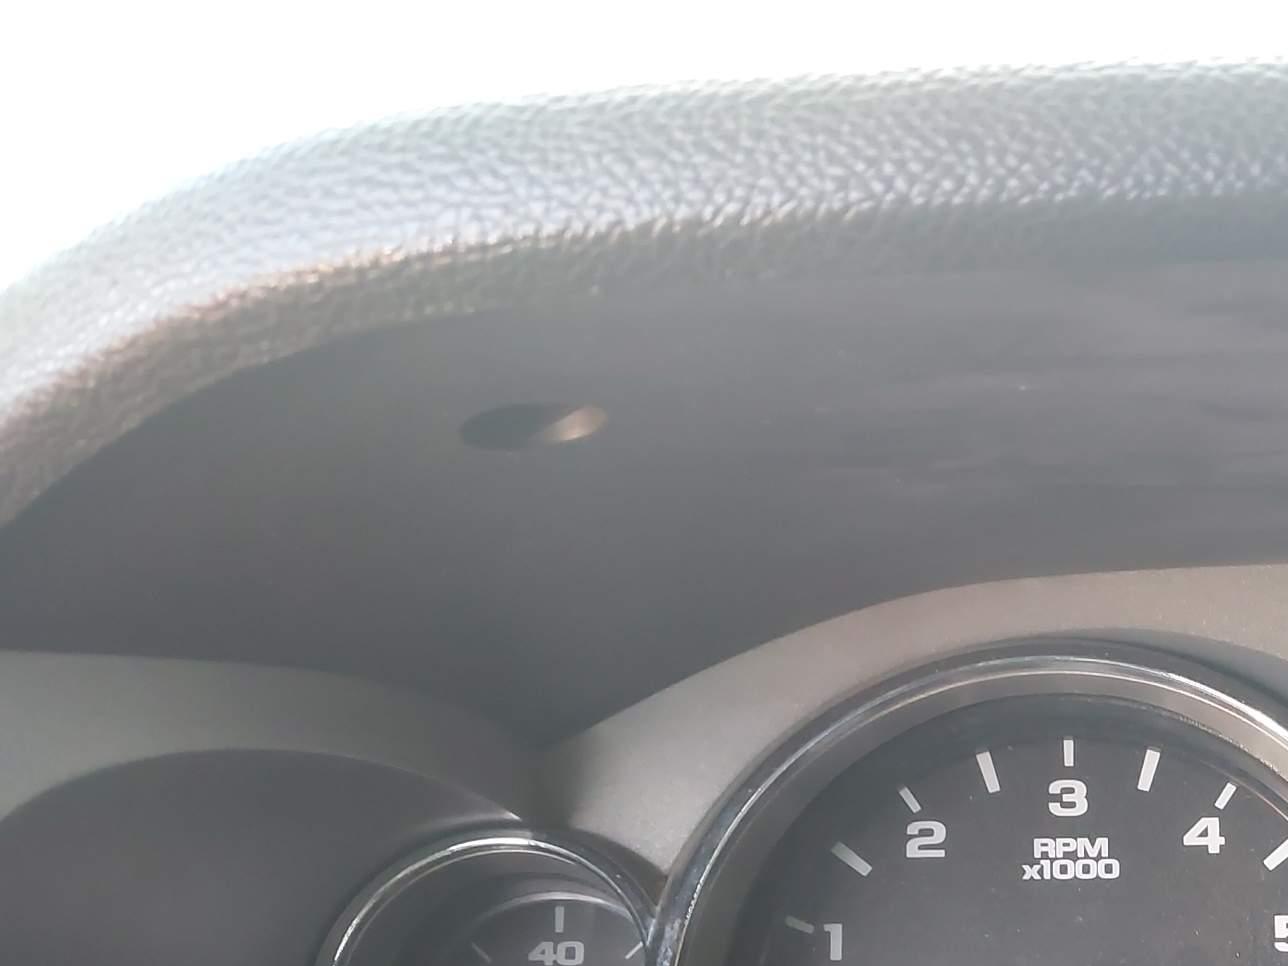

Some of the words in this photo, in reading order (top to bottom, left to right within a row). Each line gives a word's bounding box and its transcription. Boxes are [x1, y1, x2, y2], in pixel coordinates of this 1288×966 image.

[1048, 779, 1088, 817] 3
[906, 820, 946, 858] 2
[1033, 837, 1109, 859] RPM
[1183, 817, 1225, 854] 4
[1022, 858, 1120, 880] x1000
[527, 941, 584, 966] 40
[823, 923, 843, 961] 1
